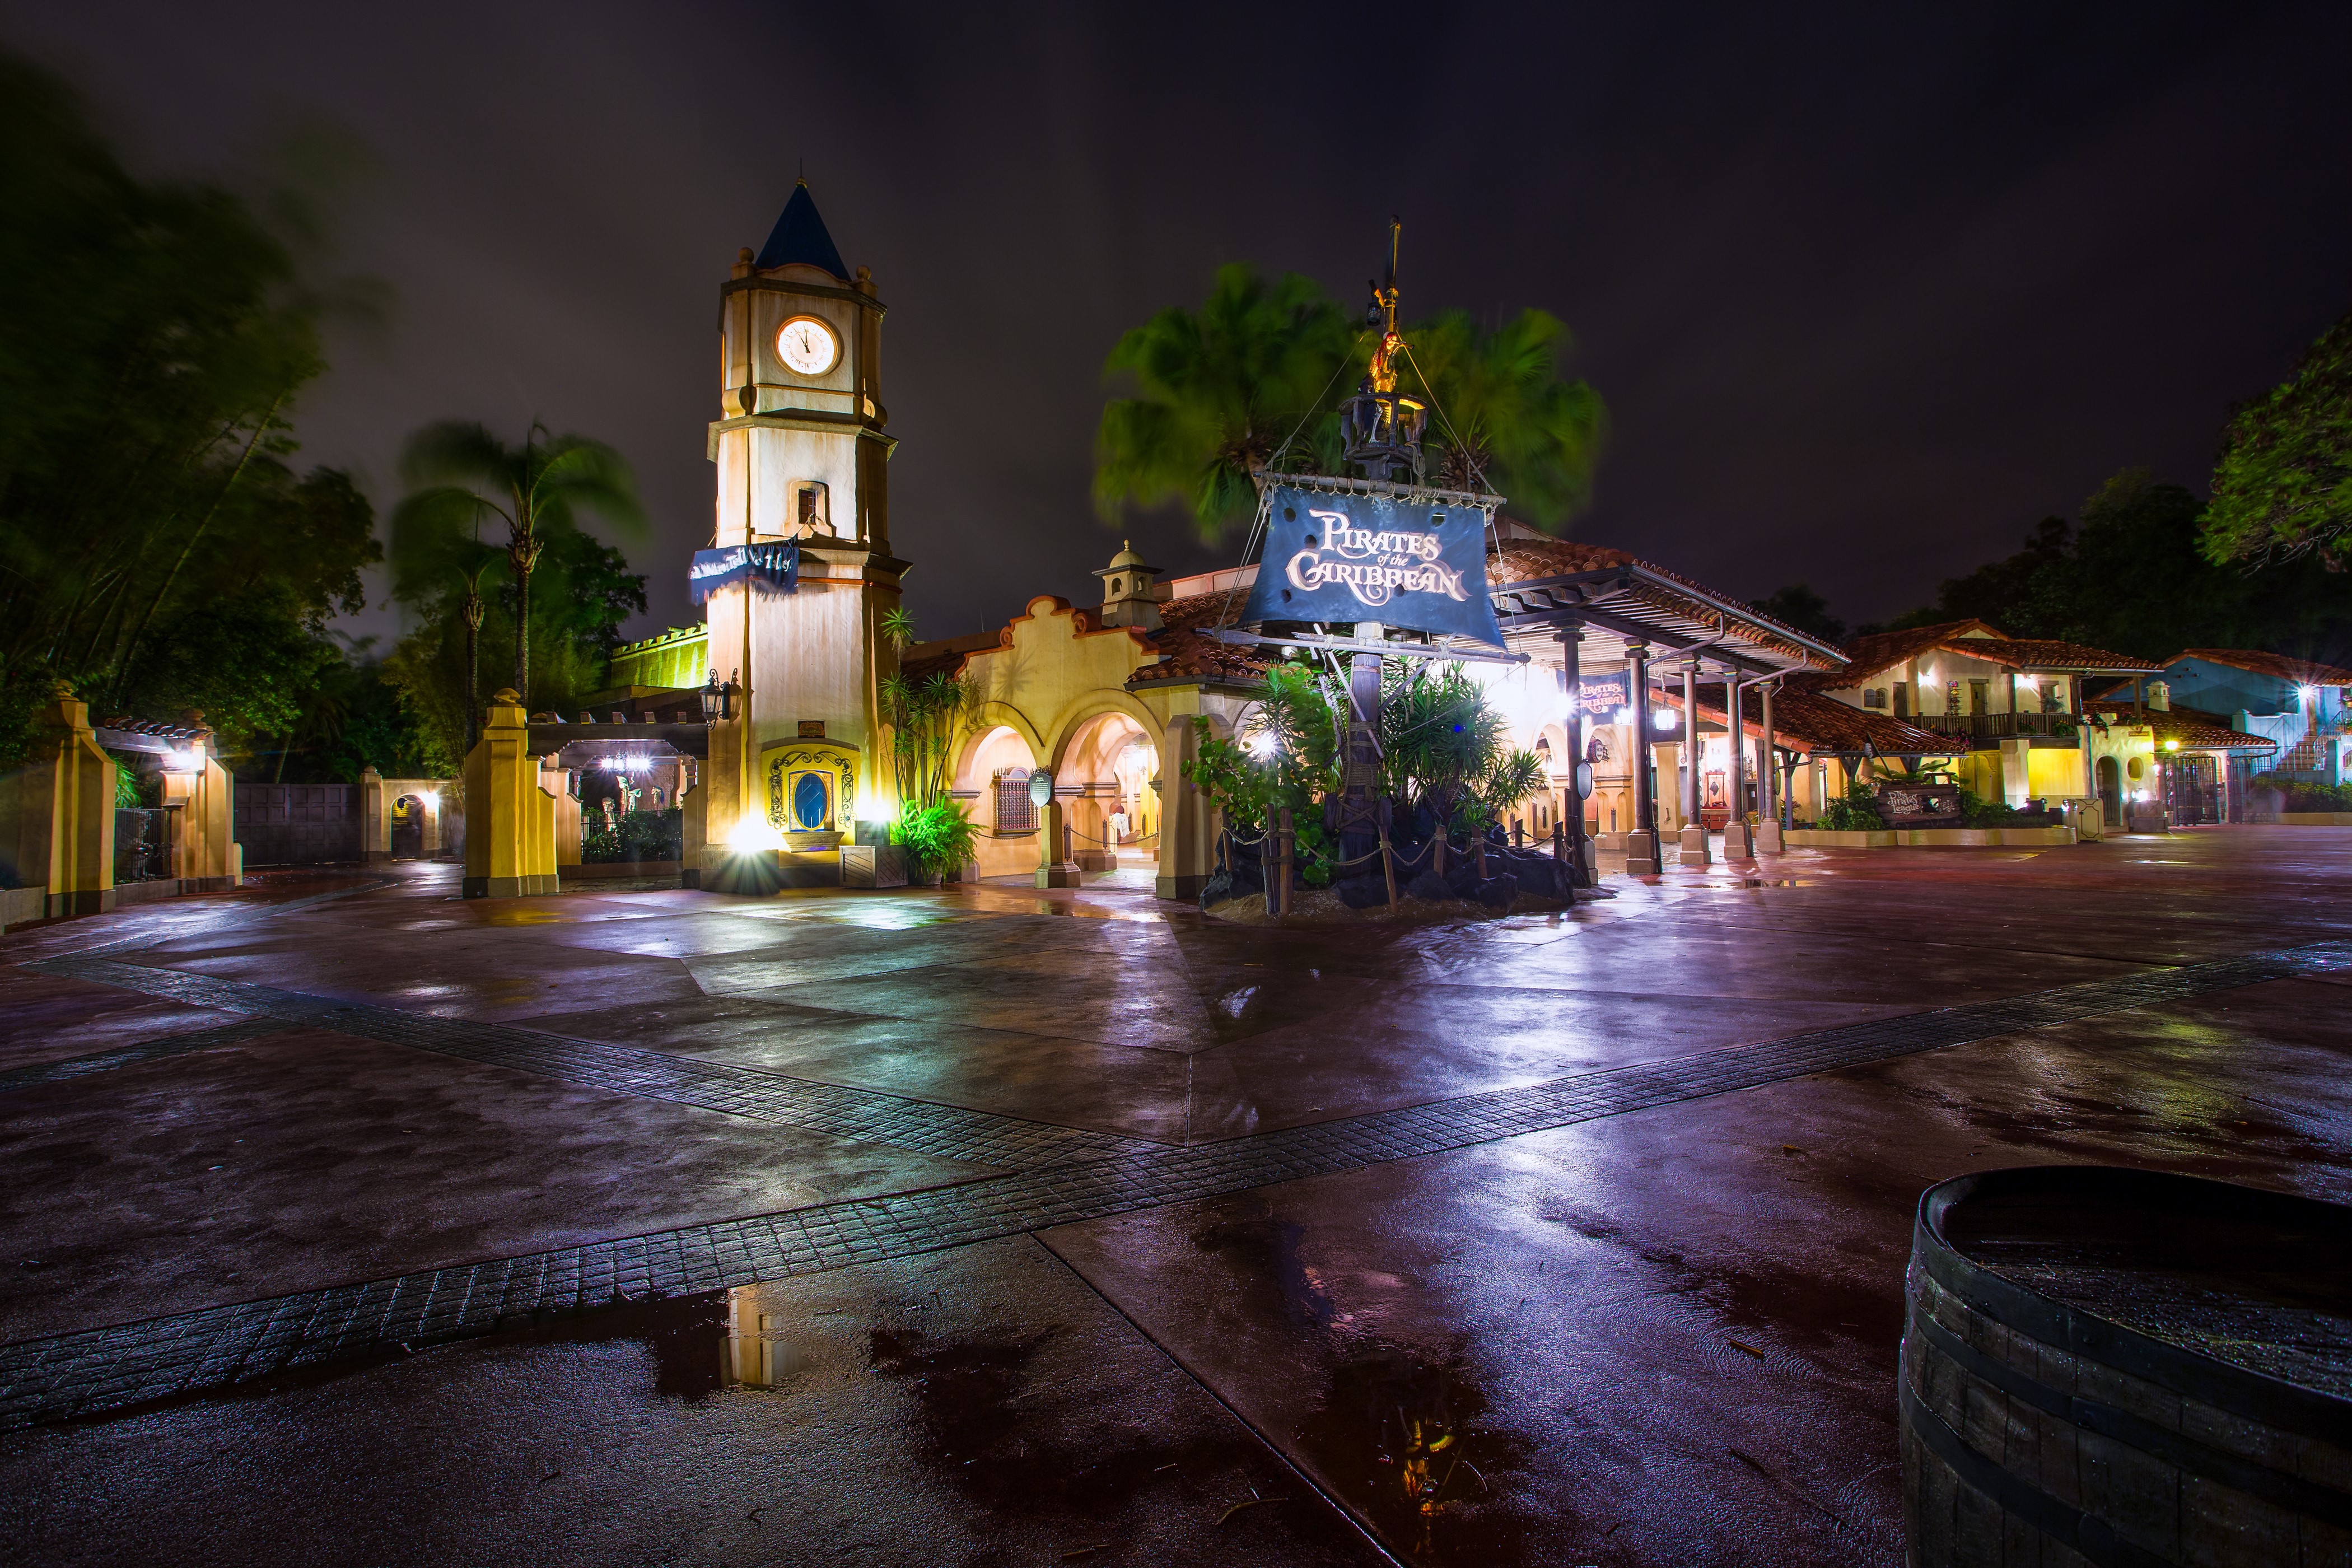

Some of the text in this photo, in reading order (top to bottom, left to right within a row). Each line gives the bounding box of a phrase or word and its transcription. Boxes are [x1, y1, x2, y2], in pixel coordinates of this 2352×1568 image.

[1309, 508, 1443, 561] PIRATES
[1376, 553, 1408, 567] of the
[1285, 549, 1472, 606] CARIBBEAN
[1887, 792, 1917, 806] Pirates
[1893, 790, 1907, 799] The
[1891, 804, 1920, 815] League
